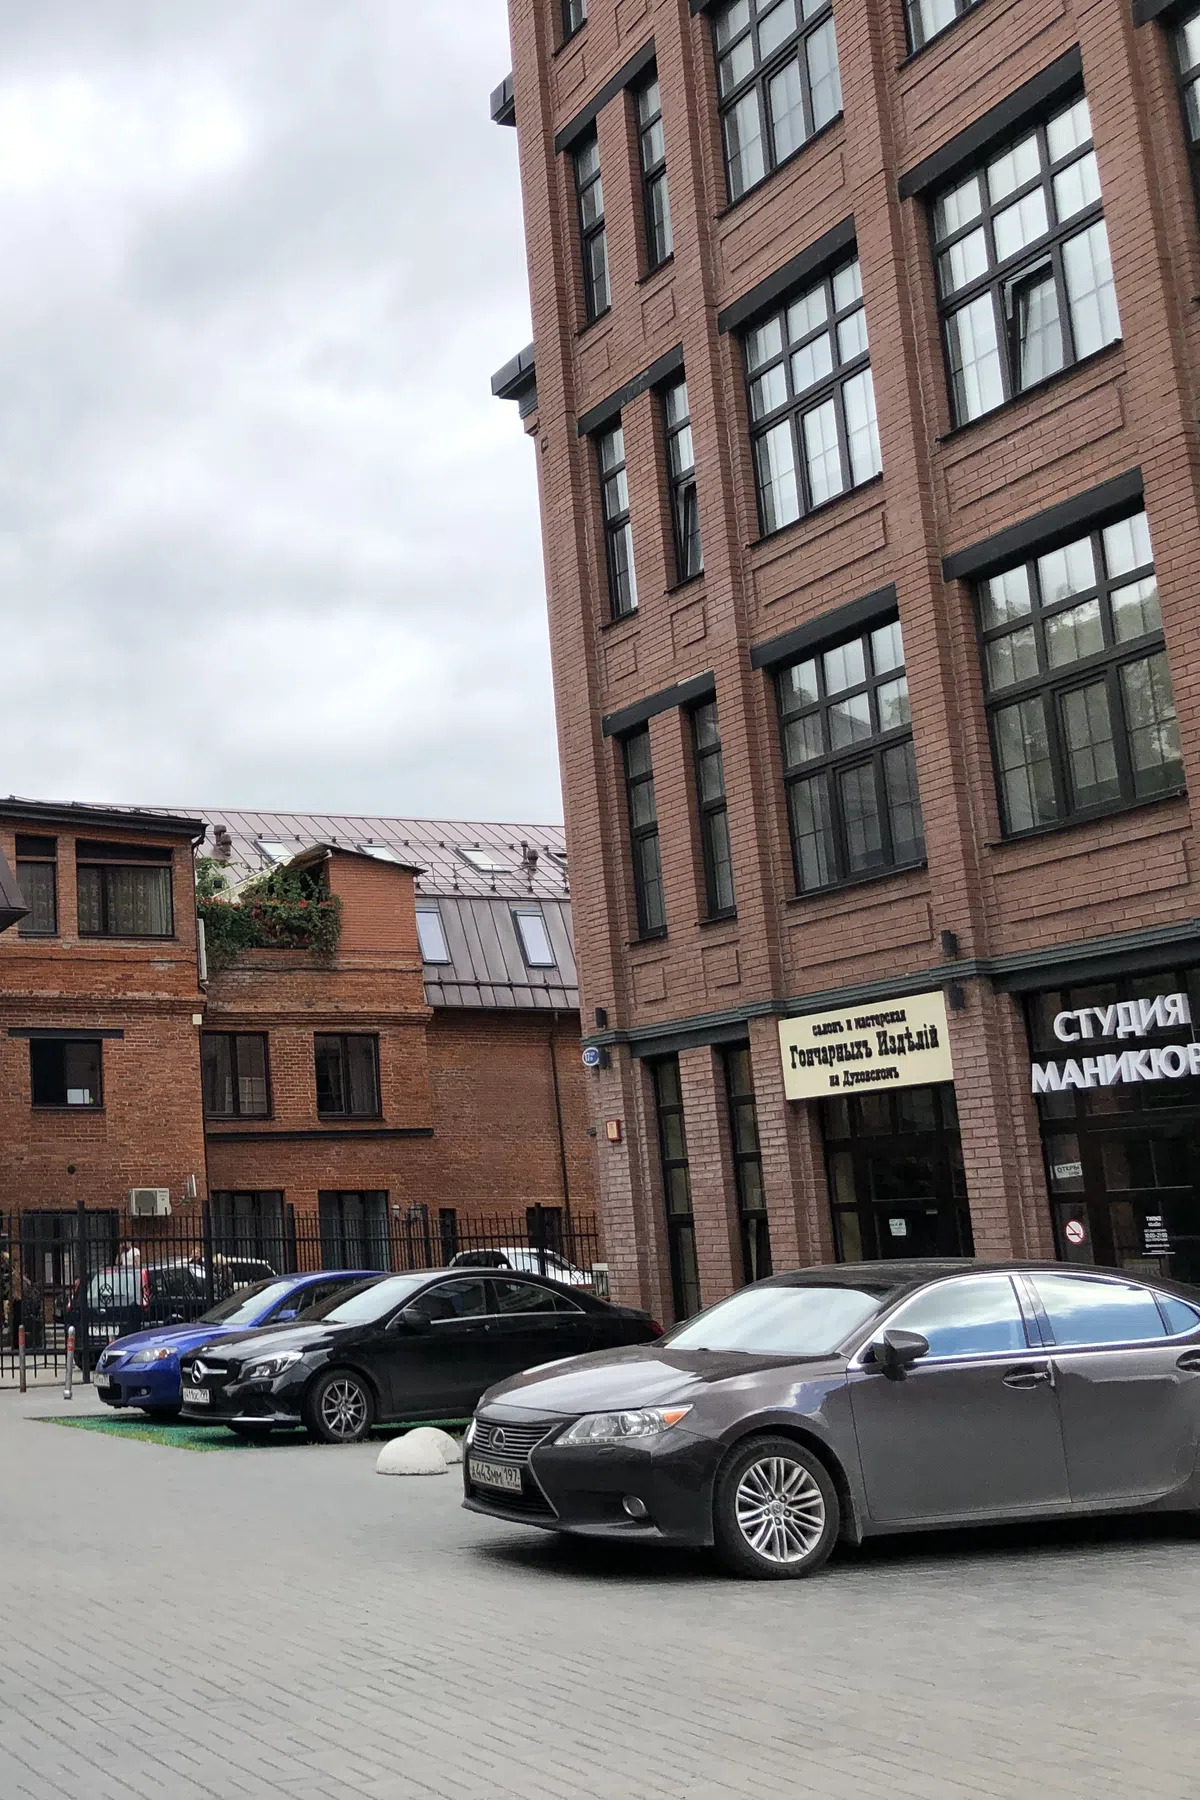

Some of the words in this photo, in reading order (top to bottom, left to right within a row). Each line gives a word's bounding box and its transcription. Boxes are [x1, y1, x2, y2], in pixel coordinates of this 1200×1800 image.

[846, 1018, 853, 1031] и
[854, 1009, 907, 1030] мастерская
[1053, 993, 1192, 1042] СТУДИЯ
[789, 1039, 873, 1069] Гончарныхъ
[829, 1074, 840, 1087] на
[1031, 1042, 1200, 1093] МАНИКЮР
[503, 1467, 518, 1482] 197
